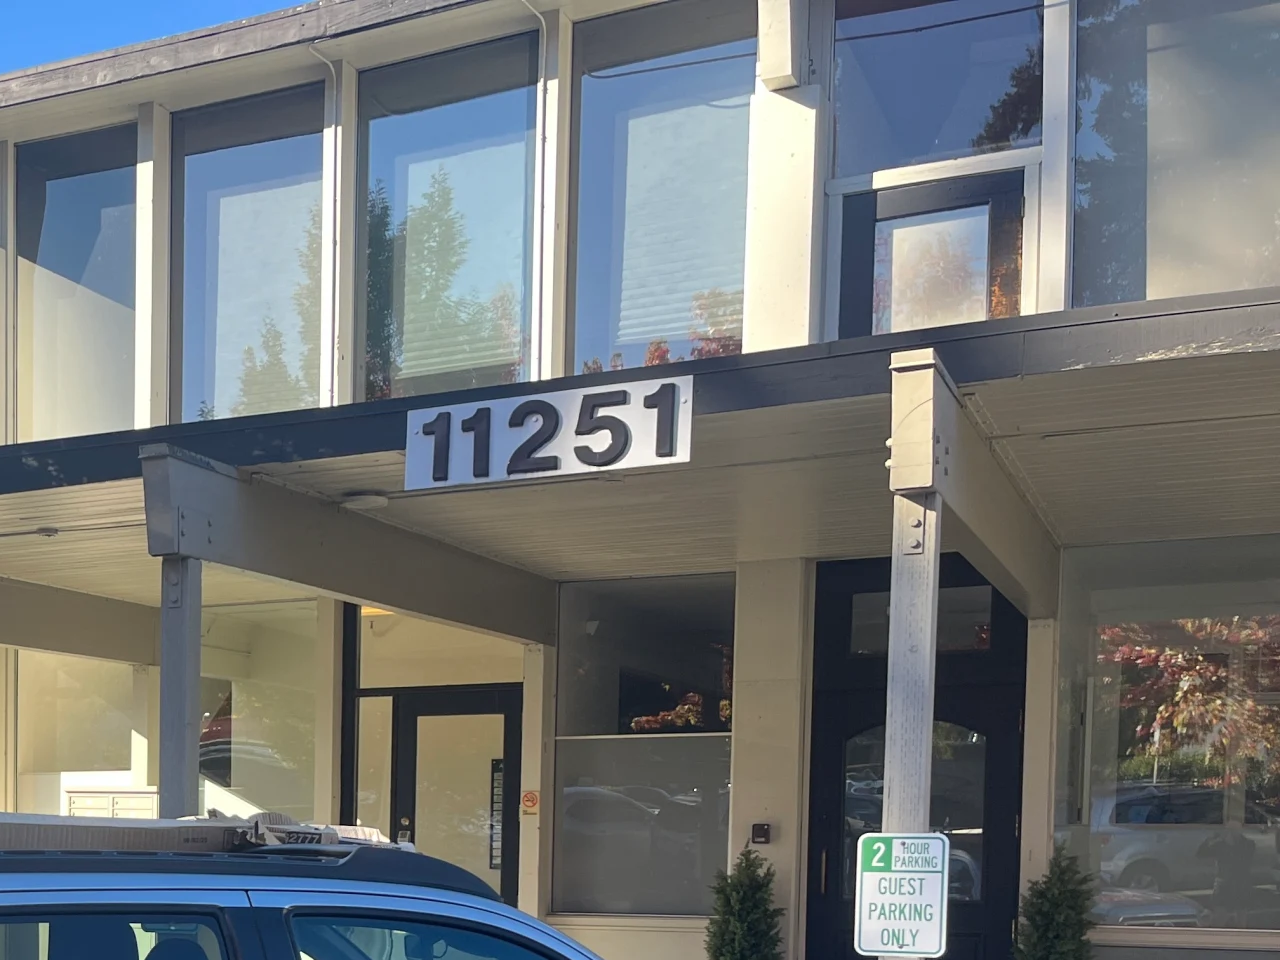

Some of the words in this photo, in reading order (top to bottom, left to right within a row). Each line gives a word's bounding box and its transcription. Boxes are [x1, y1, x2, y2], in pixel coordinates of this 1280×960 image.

[421, 382, 677, 482] 11251
[871, 841, 886, 867] 2
[902, 842, 930, 855] HOUR
[893, 855, 938, 869] PARKING
[878, 877, 925, 896] GUEST
[868, 902, 934, 922] PARKING
[880, 928, 919, 948] ONLY
